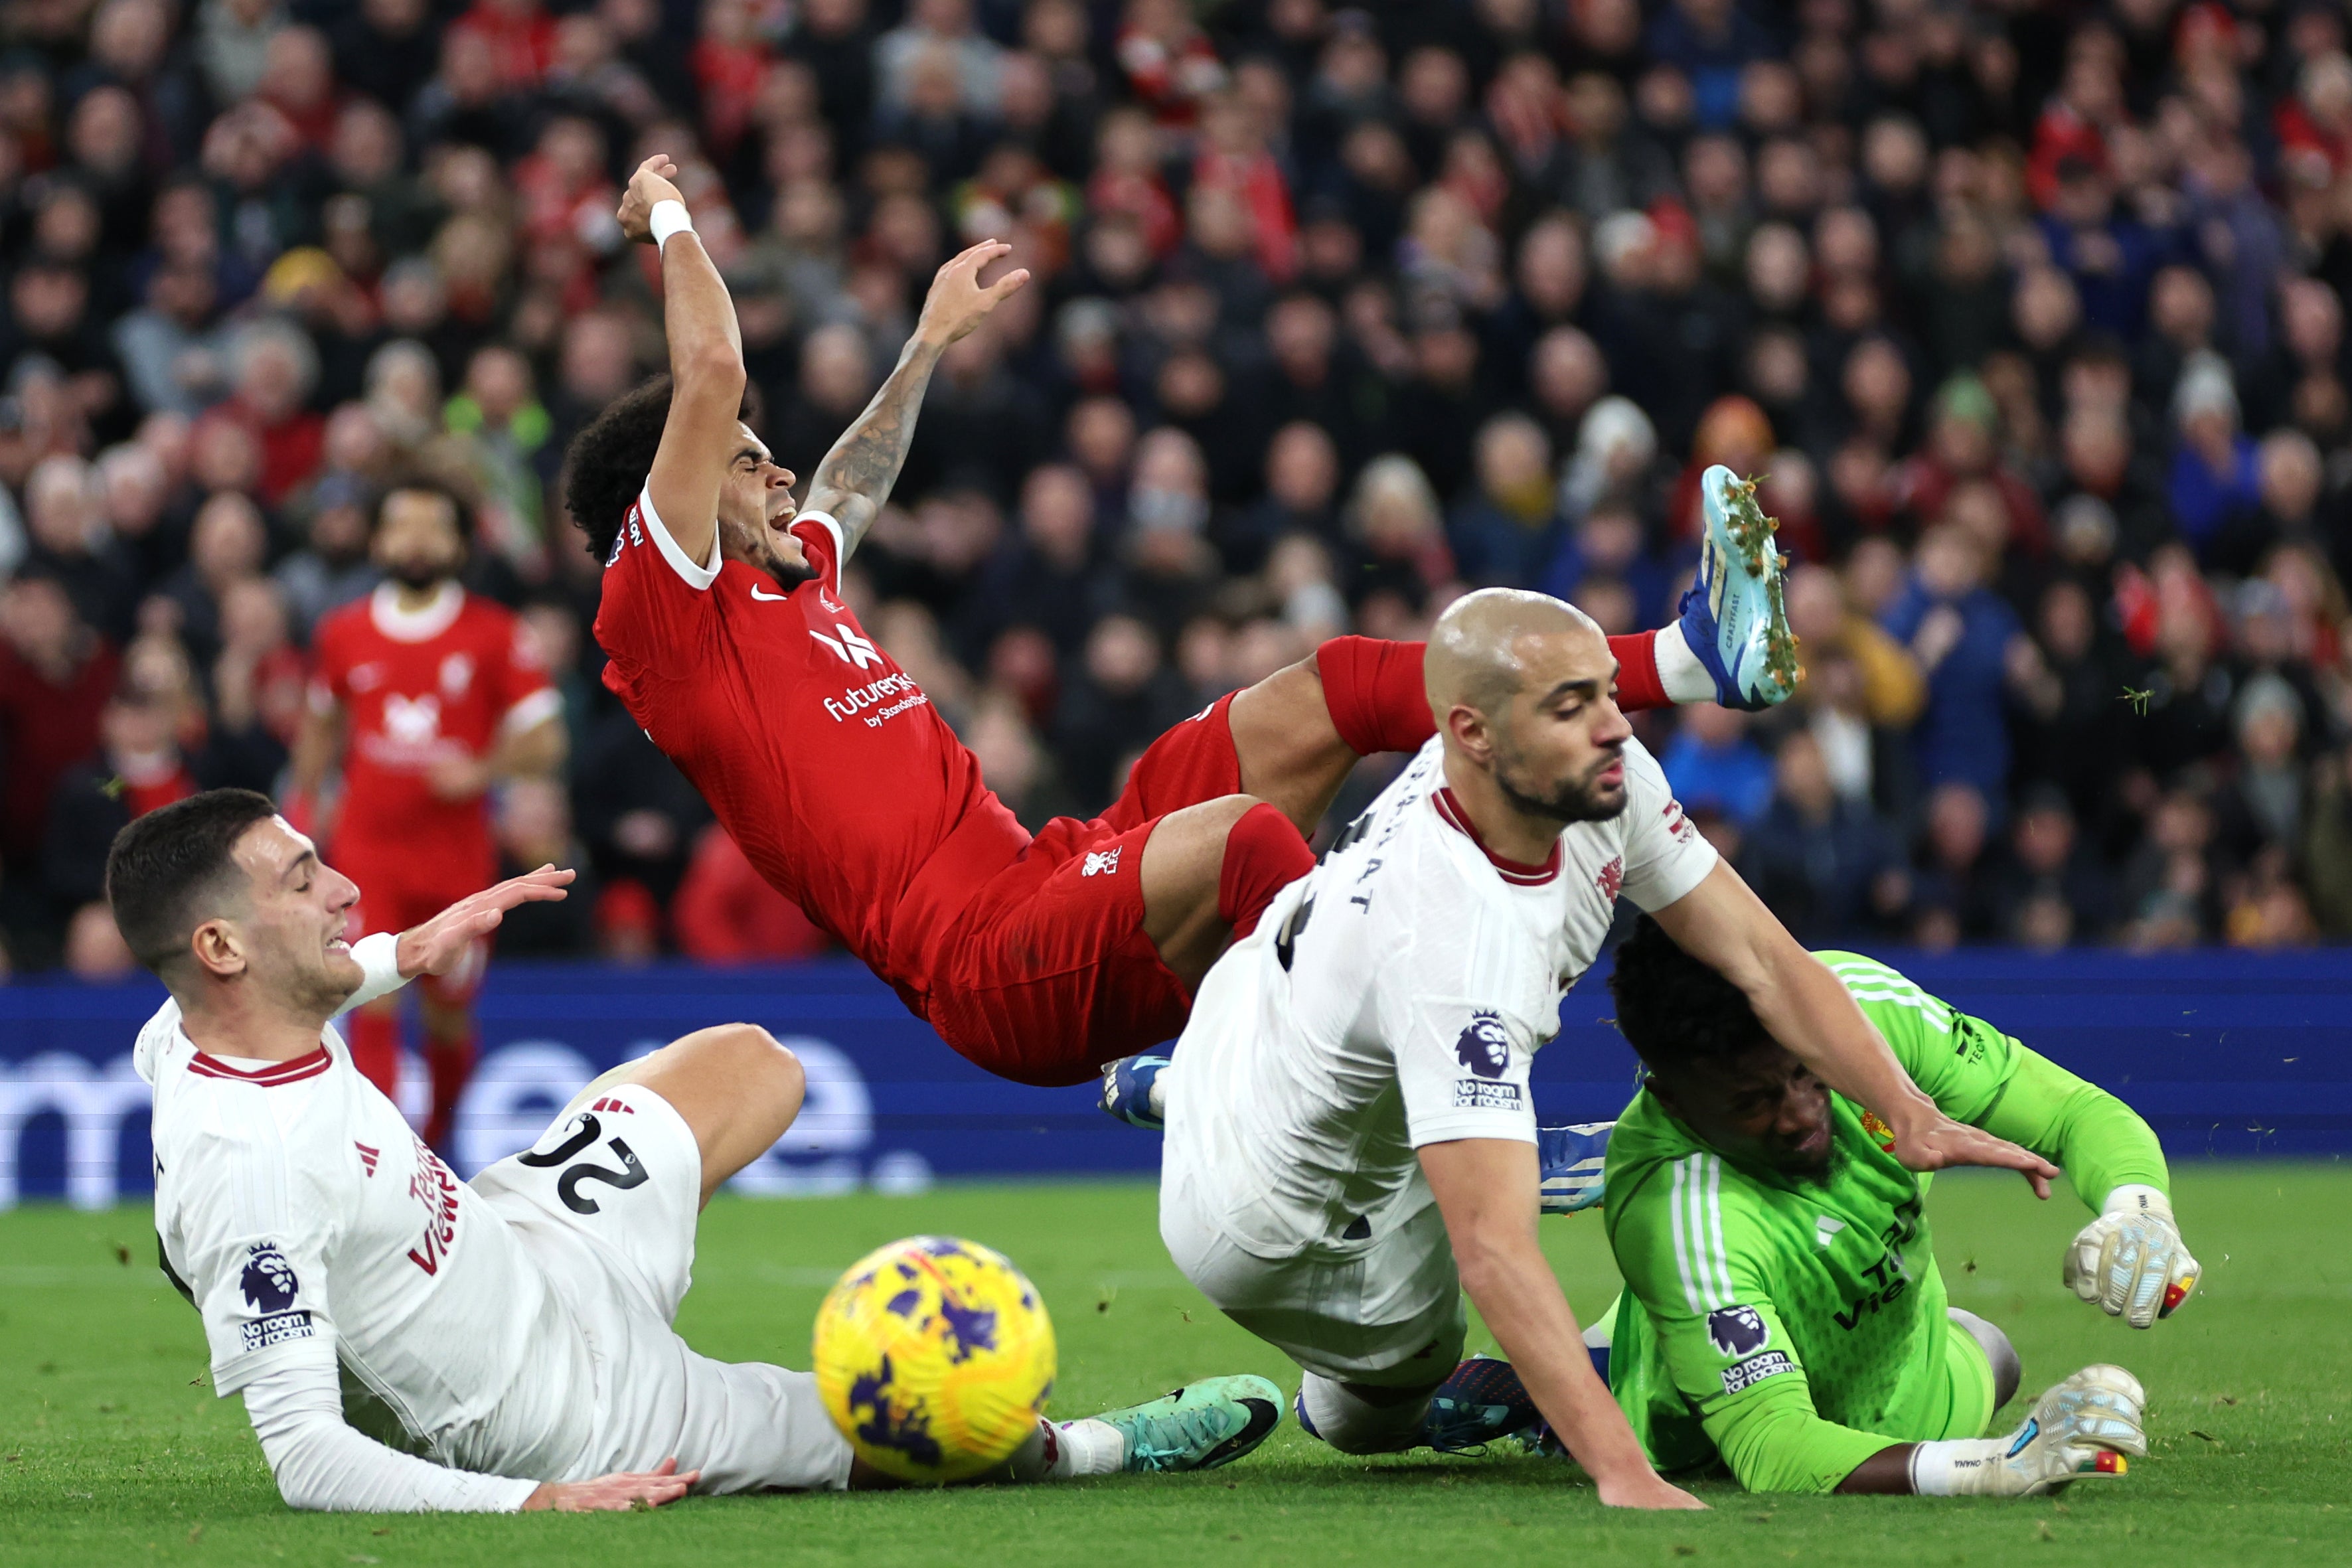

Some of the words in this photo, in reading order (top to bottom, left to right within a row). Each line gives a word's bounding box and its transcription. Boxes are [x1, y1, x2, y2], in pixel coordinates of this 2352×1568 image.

[864, 714, 882, 728] by
[1454, 1080, 1476, 1095] No
[1476, 1082, 1516, 1099] room
[1452, 1094, 1476, 1107] for
[1476, 1094, 1524, 1111] racism
[239, 1323, 262, 1341] No
[262, 1314, 305, 1333] room
[242, 1335, 264, 1352] for
[264, 1324, 315, 1346] racism
[1720, 1367, 1744, 1384] No
[1743, 1352, 1786, 1374] room
[1724, 1377, 1746, 1395] for
[1746, 1362, 1796, 1385] racism
[1954, 1459, 1982, 1468] ONANA
